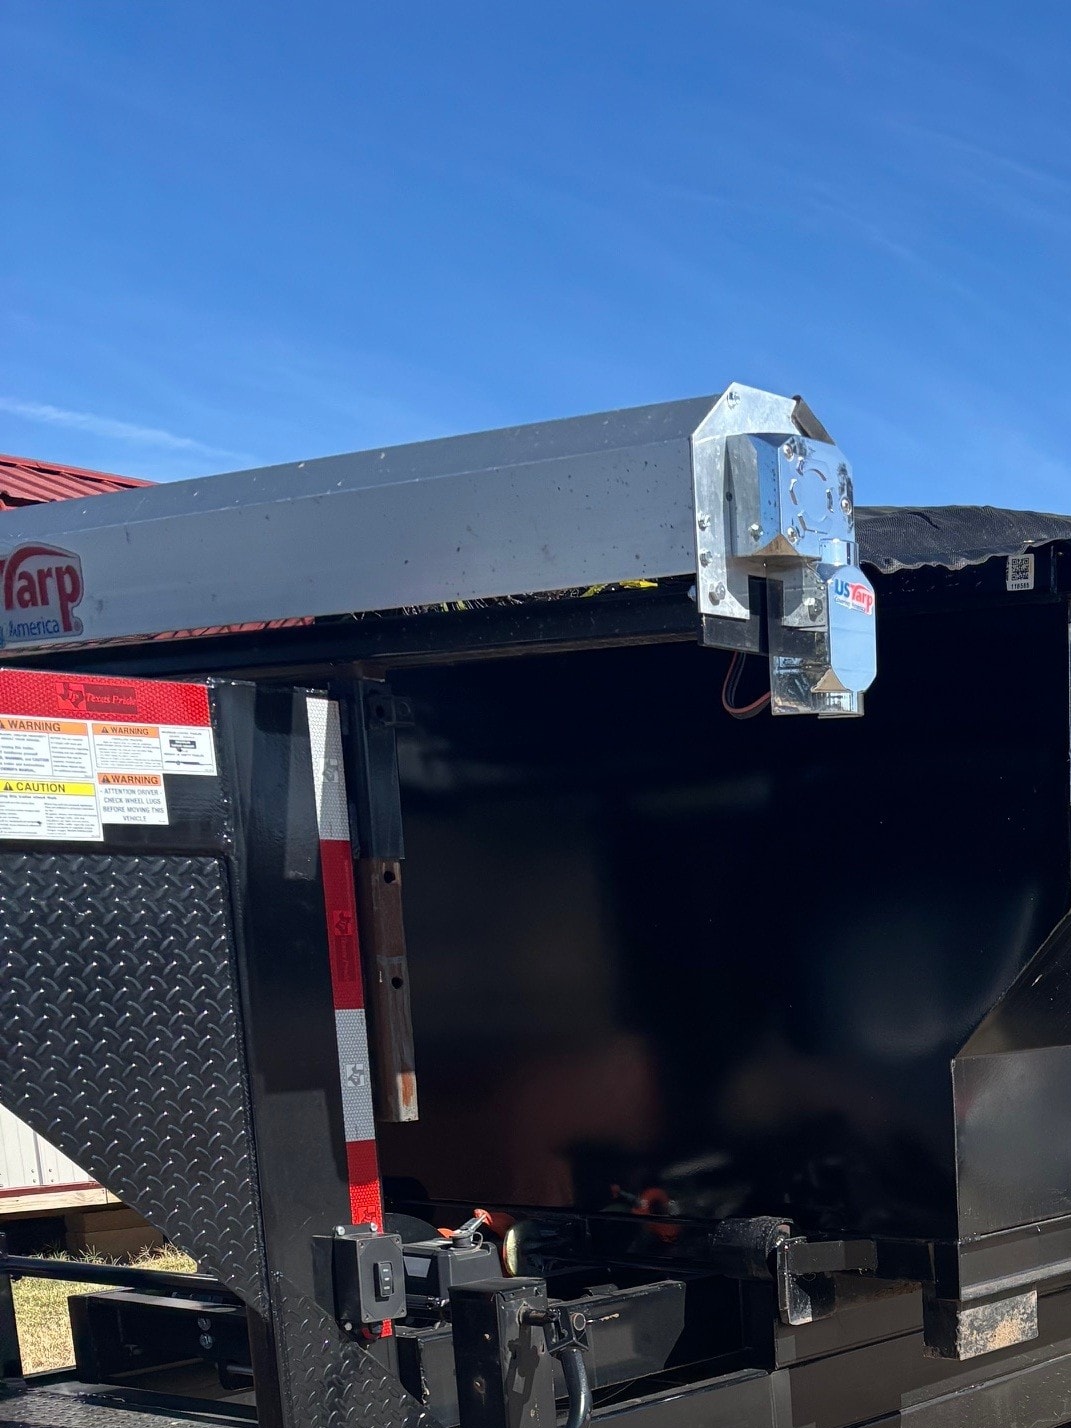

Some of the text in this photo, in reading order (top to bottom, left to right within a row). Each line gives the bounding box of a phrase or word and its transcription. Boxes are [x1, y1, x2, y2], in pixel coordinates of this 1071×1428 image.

[0, 546, 81, 632] Tarp
[8, 618, 60, 638] America
[7, 719, 61, 732] WARNING
[110, 726, 149, 736] WARNING
[111, 775, 159, 785] WARNING
[16, 782, 66, 793] CAUTION
